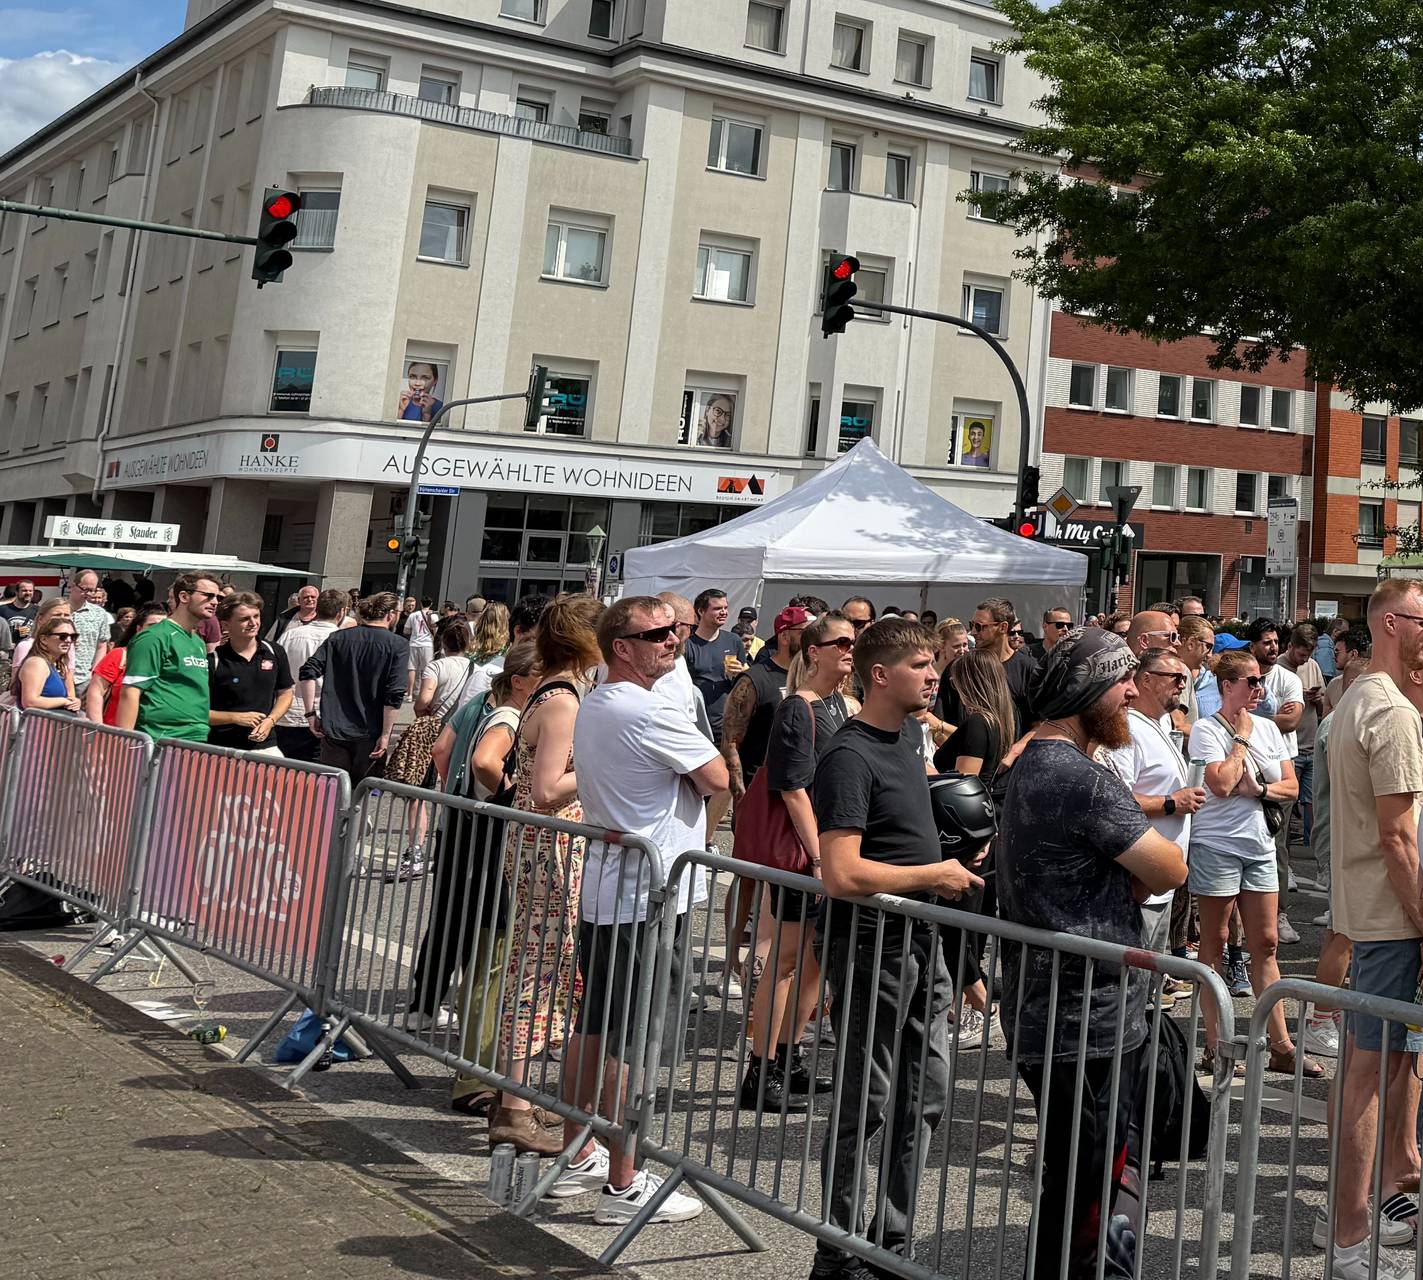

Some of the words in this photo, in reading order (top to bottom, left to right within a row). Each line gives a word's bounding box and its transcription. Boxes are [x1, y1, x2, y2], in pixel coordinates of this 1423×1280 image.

[124, 454, 168, 480] AUSGEWÄHLTE
[168, 450, 209, 473] WOHNIDEEN
[239, 455, 299, 468] HANKE
[382, 454, 556, 484] AUSGEWÄHLTE
[562, 467, 693, 493] WOHNIDEEN
[76, 522, 106, 536] Stauder
[129, 525, 158, 539] Stauder
[1064, 523, 1091, 544] My
